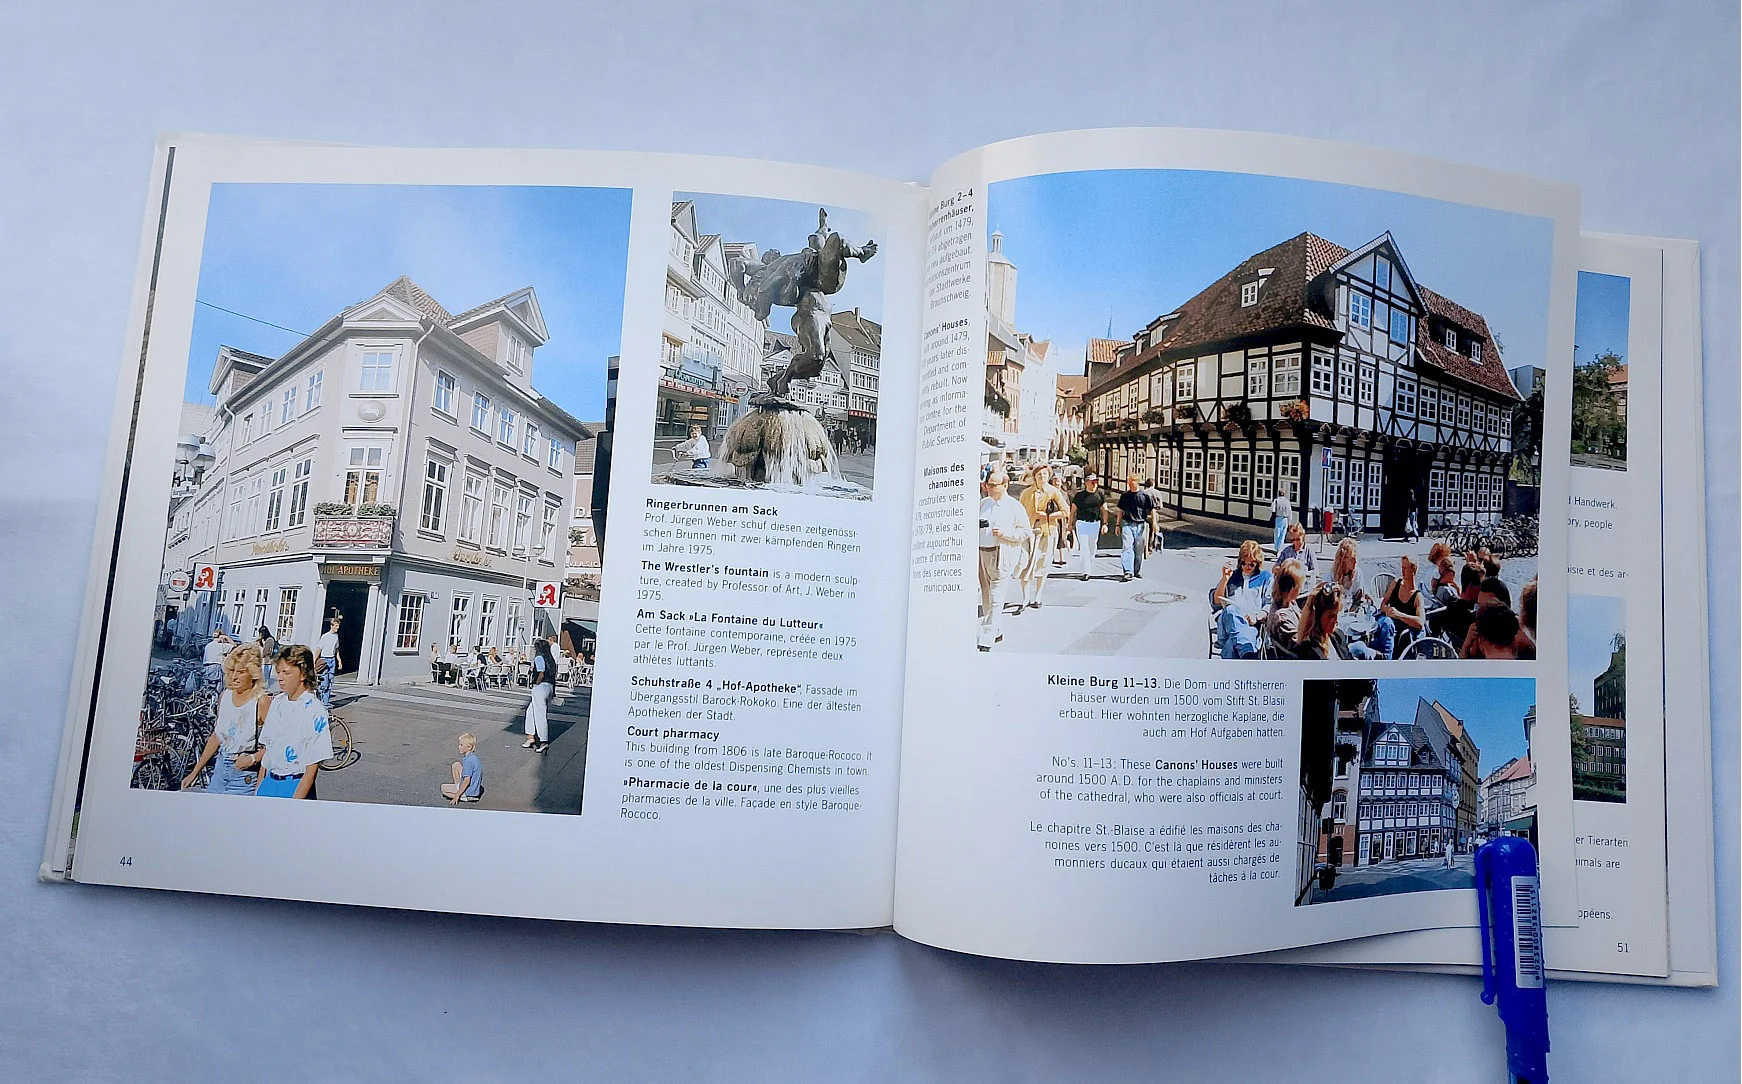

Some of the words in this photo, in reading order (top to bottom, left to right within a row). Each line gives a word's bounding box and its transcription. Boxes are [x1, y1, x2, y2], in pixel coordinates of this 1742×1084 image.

[951, 376, 968, 386] Now
[954, 404, 967, 414] the
[958, 417, 967, 428] of
[950, 463, 965, 473] des
[928, 478, 965, 490] chanoines
[948, 493, 964, 502] vers
[1574, 496, 1618, 509] Handwerk.
[646, 498, 728, 513] Ringerbrunnen
[731, 505, 749, 514] am
[752, 505, 778, 517] Sack
[1584, 520, 1613, 530] people
[642, 543, 655, 552] im
[657, 542, 685, 554] Jahre
[688, 544, 715, 556] 1975.
[641, 560, 661, 571] The
[664, 561, 720, 575] Wrestler's
[724, 565, 769, 578] fountain
[773, 571, 781, 579] is
[784, 571, 790, 580] a
[794, 571, 831, 583] modern
[834, 575, 861, 586] sculp-
[933, 567, 962, 577] services
[1587, 567, 1595, 576] et
[1598, 568, 1614, 577] des
[636, 589, 664, 601] 1975.
[636, 608, 655, 619] Am
[659, 609, 686, 621] Sack
[711, 612, 758, 626] Fontaine
[762, 616, 776, 627] du
[635, 623, 662, 635] Cette
[665, 624, 706, 638] fontaine
[710, 629, 786, 644] contemporaine,
[789, 633, 816, 645] créée
[819, 637, 831, 646] en
[834, 635, 857, 647] 1975
[632, 653, 672, 666] athlètes
[676, 655, 717, 668] luttants.
[631, 675, 701, 689] Schuhstraße
[705, 679, 713, 690] 4
[805, 684, 843, 696] Fassade
[1047, 674, 1085, 687] Kleine
[1090, 676, 1119, 690] Burg
[1164, 678, 1181, 690] Die
[1184, 678, 1211, 690] Dom-
[1213, 679, 1230, 690] und
[1234, 679, 1287, 690] Stiftsherren-
[627, 706, 682, 719] Apotheken
[685, 708, 703, 720] der
[706, 709, 736, 721] Stadt.
[627, 725, 659, 737] Court
[662, 727, 720, 742] pharmacy
[1142, 726, 1167, 738] auch
[1171, 729, 1186, 738] am
[1190, 726, 1207, 738] Hof
[1210, 727, 1253, 740] Aufgaben
[1256, 727, 1285, 738] hatten.
[1120, 758, 1151, 770] These
[1155, 759, 1198, 770] Canons'
[1201, 759, 1238, 770] Houses
[1241, 760, 1262, 770] were
[1265, 758, 1283, 769] built
[694, 779, 708, 791] de
[712, 780, 723, 791] la
[764, 785, 782, 794] une
[785, 783, 803, 794] des
[806, 784, 826, 796] plus
[829, 785, 860, 795] vieilles
[1036, 773, 1074, 784] around
[1078, 773, 1107, 786] 1500
[1137, 775, 1153, 787] for
[1156, 775, 1173, 787] the
[1176, 775, 1221, 789] chaplains
[1224, 775, 1241, 786] and
[1244, 774, 1283, 785] ministers
[1039, 788, 1051, 800] of
[1054, 789, 1073, 801] the
[1077, 790, 1131, 804] cathedral,
[1133, 791, 1155, 803] who
[1158, 794, 1183, 803] were
[1186, 792, 1206, 803] also
[1209, 791, 1244, 803] officials
[1246, 790, 1256, 801] at
[1258, 789, 1284, 801] court.
[620, 807, 661, 820] Rococo.
[1030, 820, 1043, 833] Le
[1047, 822, 1092, 836] chapitre
[1149, 827, 1155, 836] a
[1159, 824, 1186, 836] édifié
[1190, 824, 1203, 836] les
[1206, 825, 1244, 835] maisons
[1247, 822, 1262, 833] des
[1265, 821, 1283, 832] cha-
[1587, 835, 1631, 848] Tierarten.
[120, 856, 132, 866] 44
[1054, 858, 1106, 869] monniers
[1110, 858, 1148, 869] ducaux
[1151, 860, 1167, 871] qui
[1171, 857, 1204, 869] étaient
[1207, 855, 1230, 867] aussi
[1233, 853, 1267, 867] chargés
[1269, 852, 1280, 863] de
[1605, 860, 1621, 868] are
[1209, 871, 1238, 884] tâches
[1241, 870, 1246, 881] à
[1249, 870, 1257, 880] la
[1260, 870, 1280, 880] cour.
[1617, 942, 1629, 953] 51
